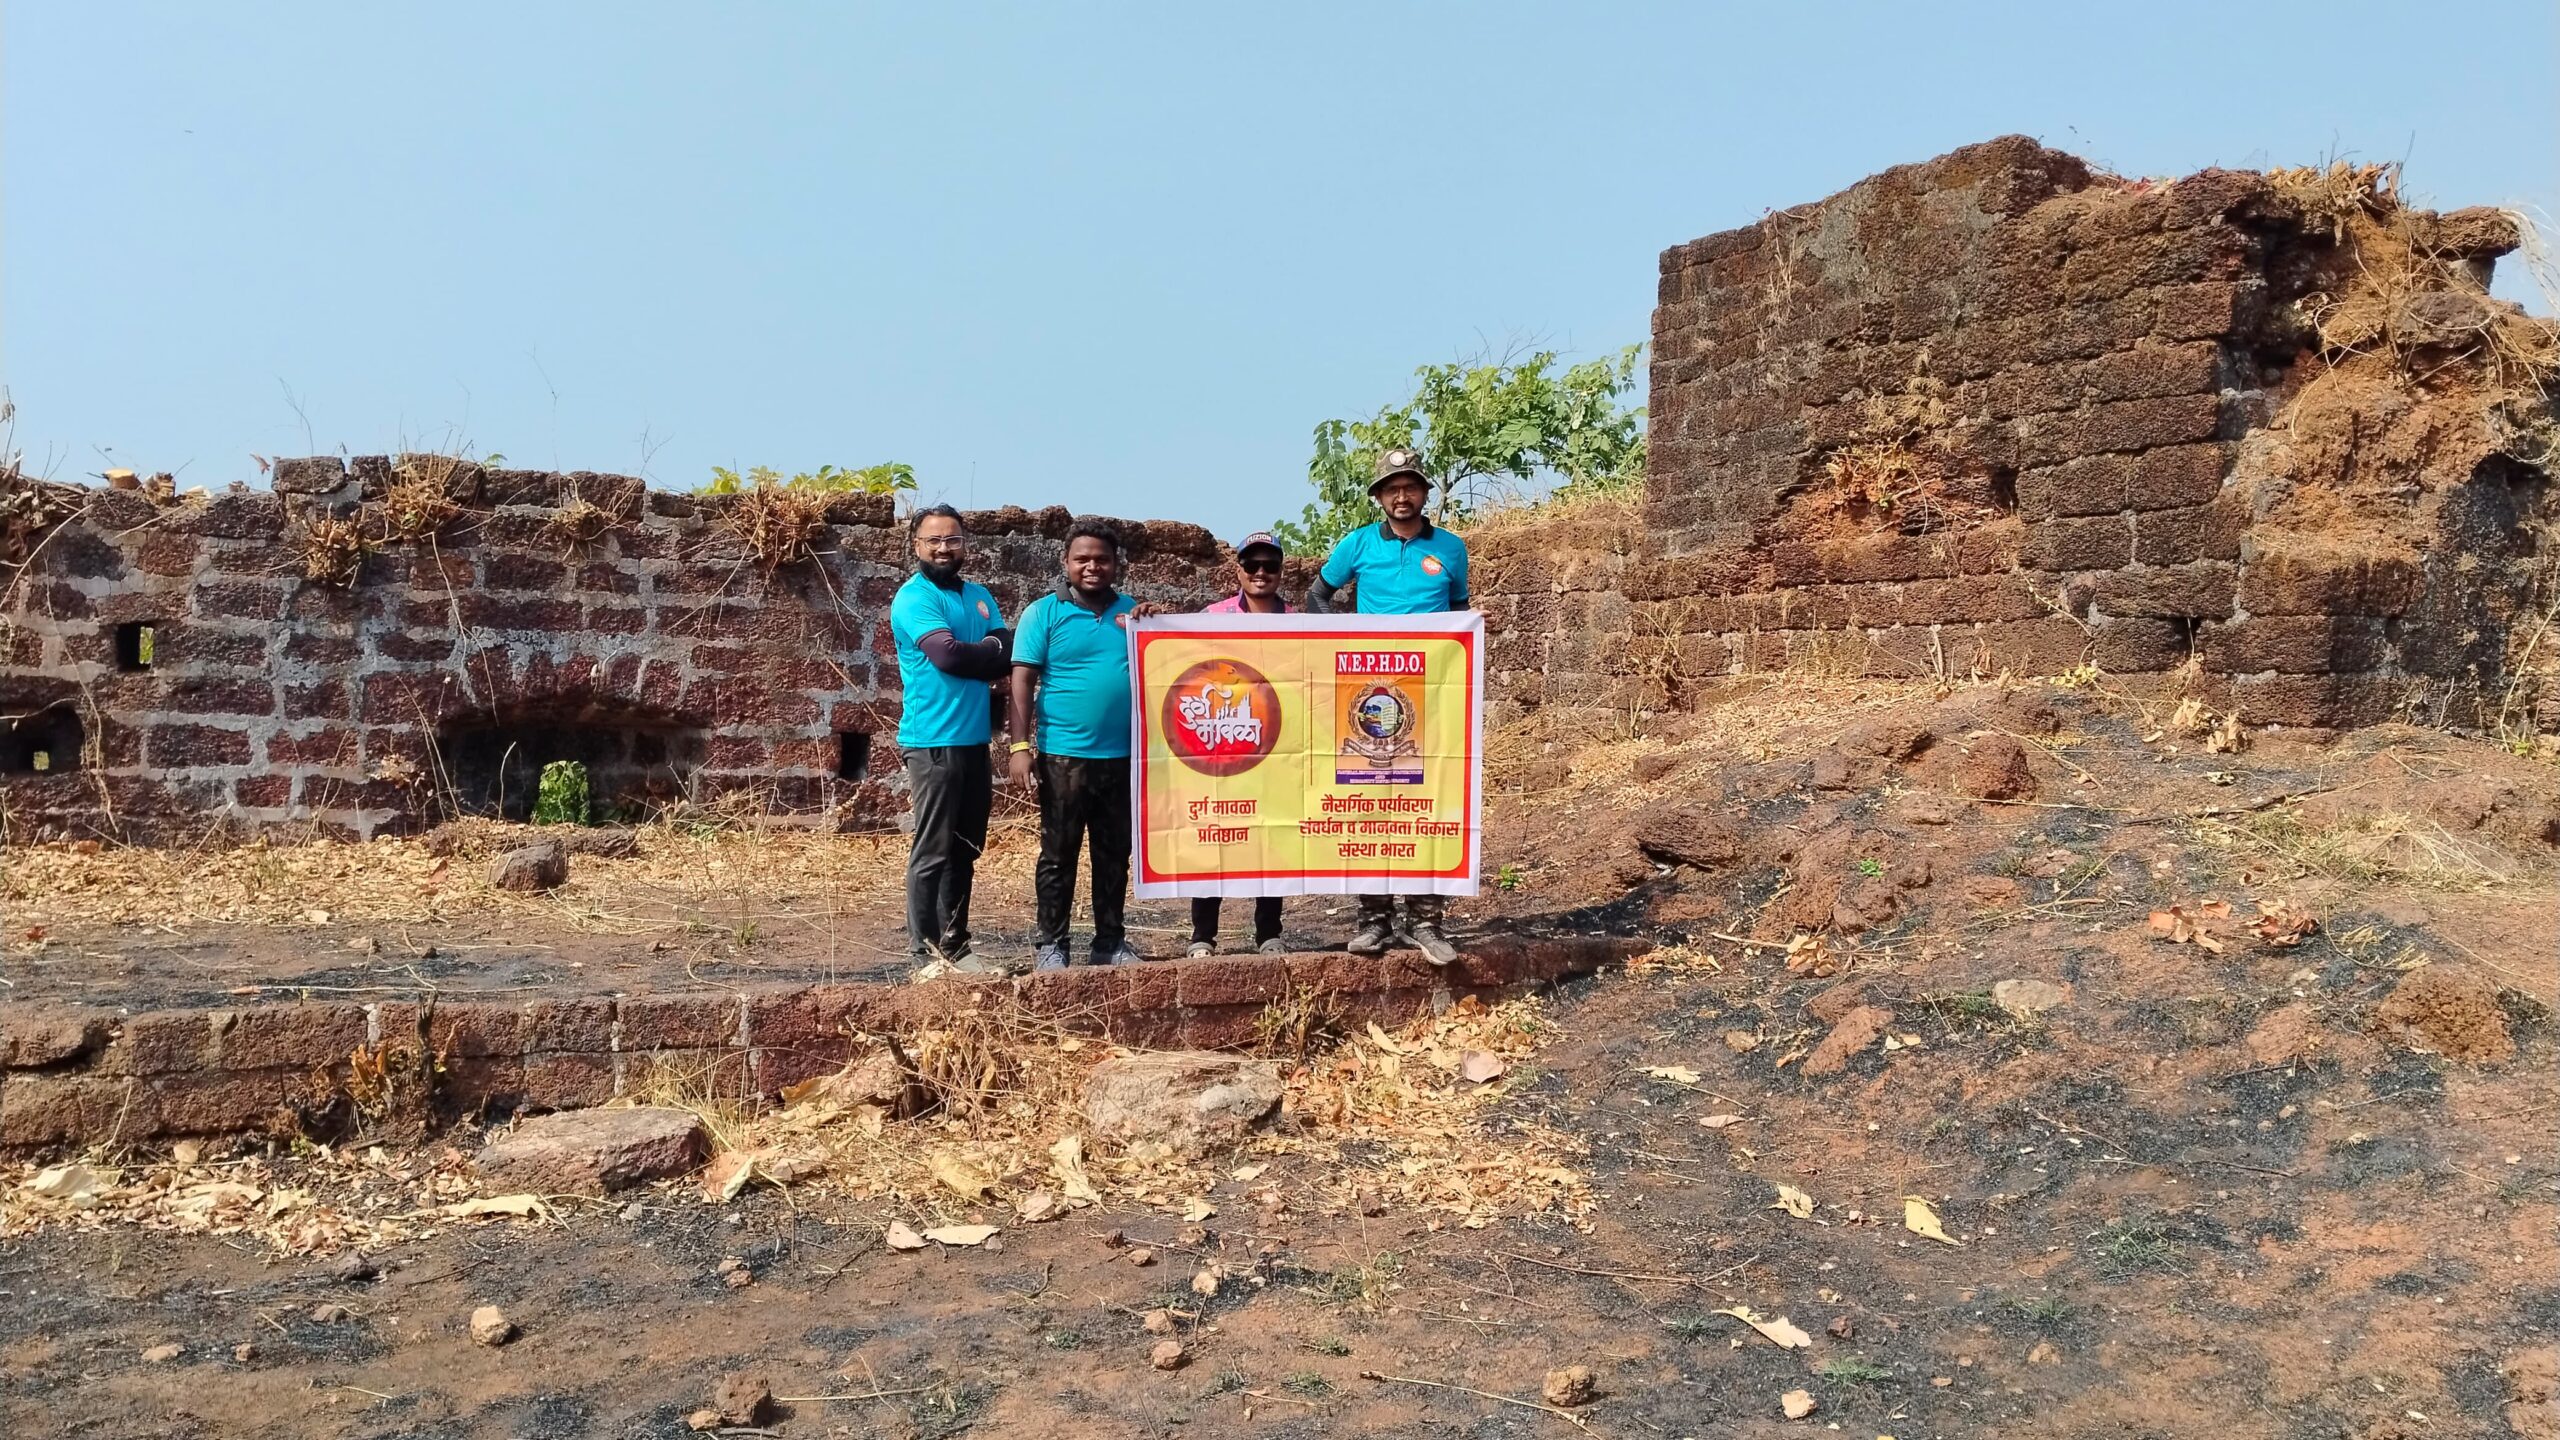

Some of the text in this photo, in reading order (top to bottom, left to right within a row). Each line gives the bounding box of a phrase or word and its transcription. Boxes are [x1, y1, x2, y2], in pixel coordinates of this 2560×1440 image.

[1338, 654, 1424, 673] N.E.P.H.D.O.
[1188, 796, 1257, 820] दुर्ग मावळा
[1321, 793, 1434, 813] नैसर्गिक पर्यावरण
[1197, 824, 1249, 843] प्रतिष्ठान
[1299, 817, 1460, 836] संवर्धन व मानवता विकास
[1338, 840, 1416, 858] संस्था भारत
